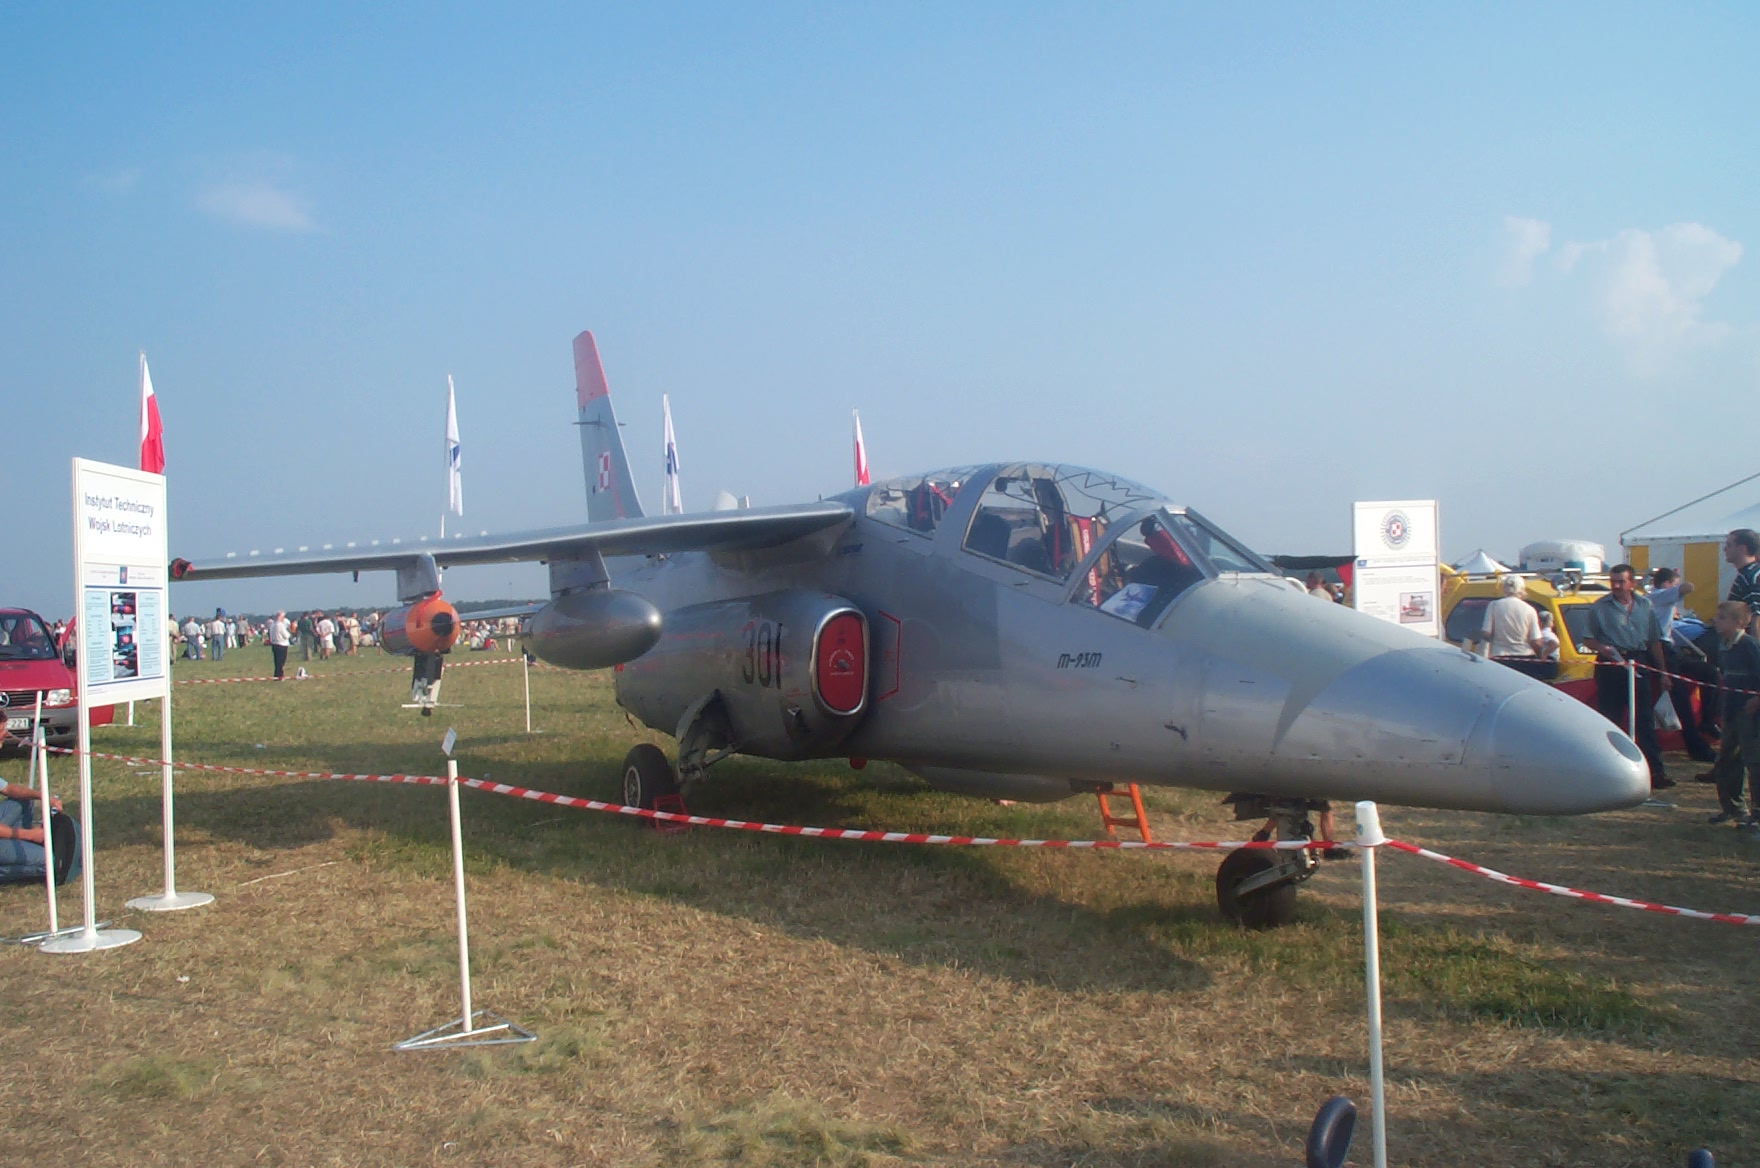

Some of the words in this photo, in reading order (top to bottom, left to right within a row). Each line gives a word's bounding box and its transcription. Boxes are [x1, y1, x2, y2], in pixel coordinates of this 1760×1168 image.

[84, 492, 113, 511] Instytut
[114, 497, 154, 518] Techniczny
[88, 516, 111, 535] Wojsk
[112, 520, 152, 538] Lotniczych
[742, 621, 783, 690] 301
